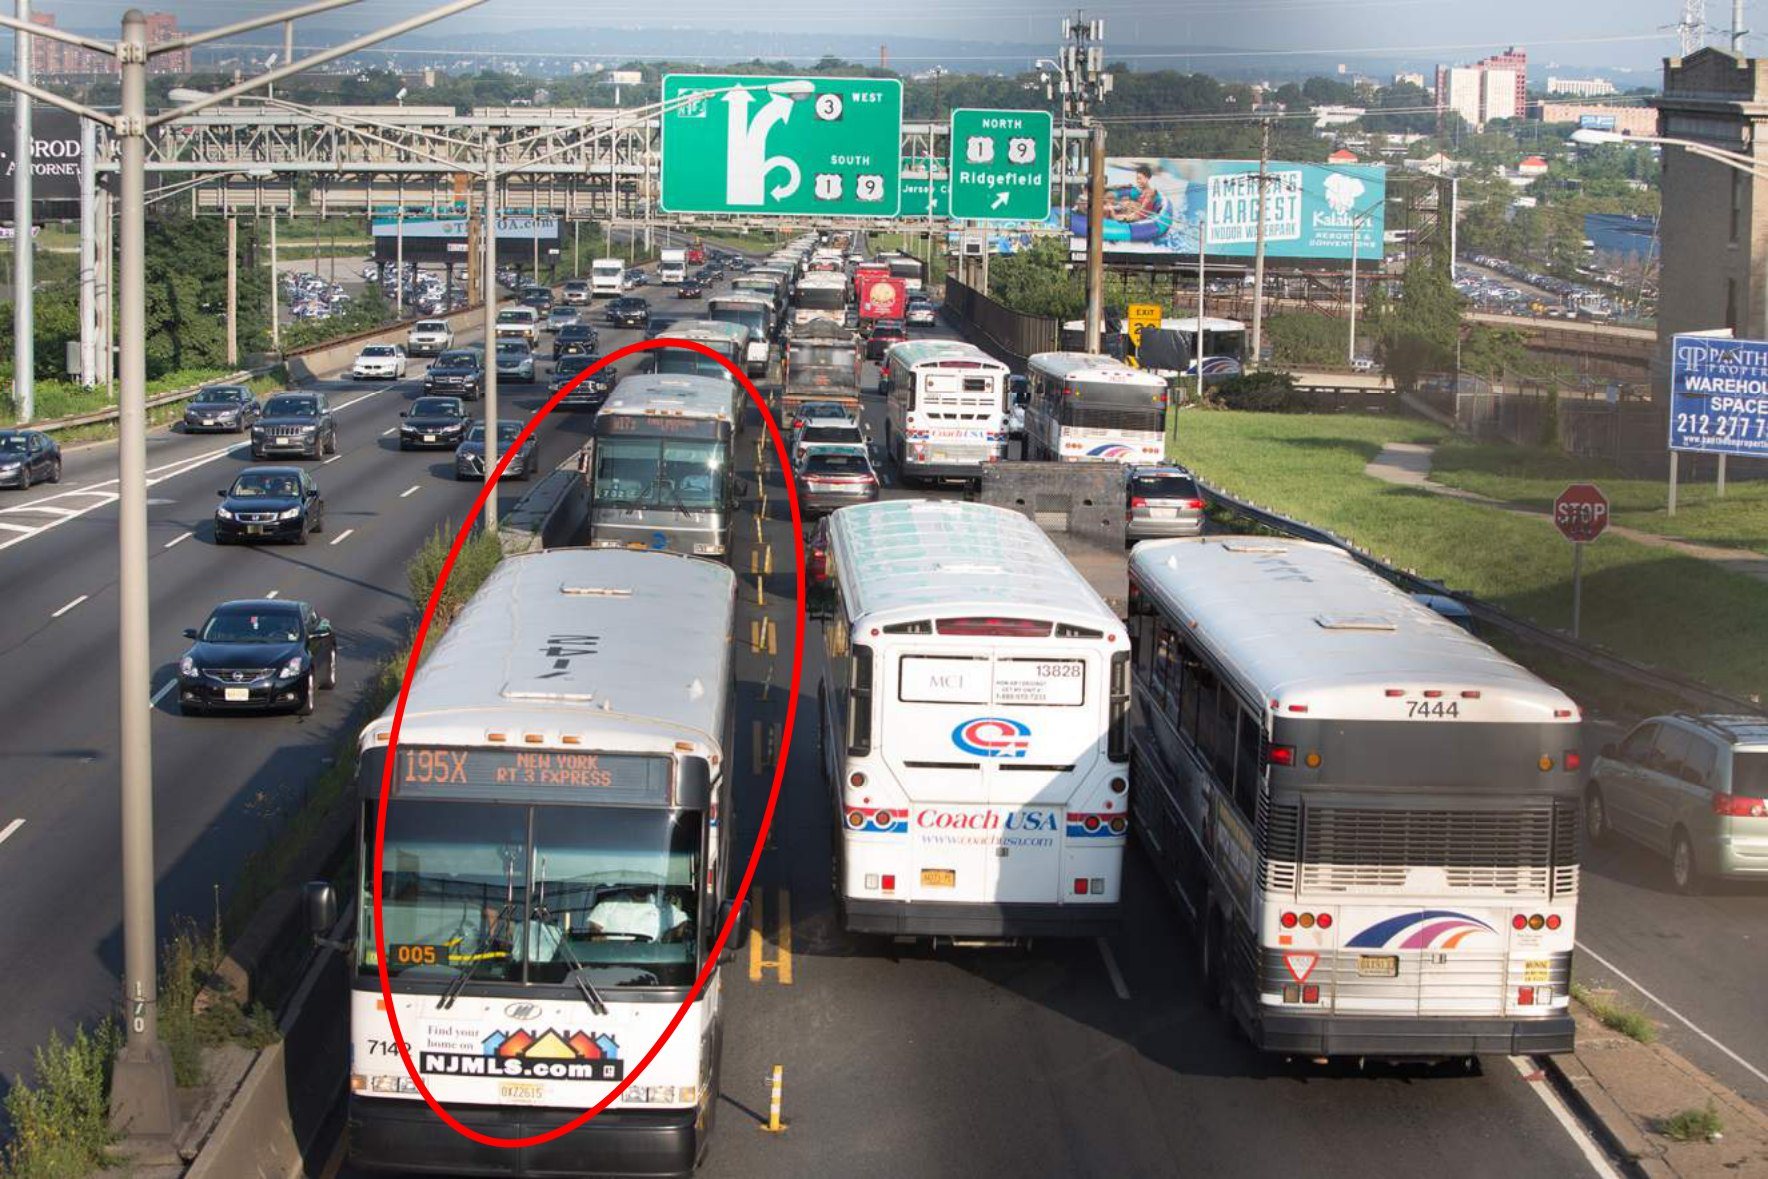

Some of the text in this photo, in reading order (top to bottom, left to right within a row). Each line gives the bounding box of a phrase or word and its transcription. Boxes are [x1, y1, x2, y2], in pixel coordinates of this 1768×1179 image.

[852, 92, 883, 103] WEST
[824, 99, 834, 115] 3
[982, 119, 1022, 129] NORTH
[1017, 143, 1027, 158] 9
[831, 155, 870, 166] SOUTH
[865, 180, 875, 195] 9
[960, 172, 1042, 187] Ridgefield
[1212, 174, 1297, 197] AMERA'S
[1711, 396, 1768, 415] SPACE
[1677, 412, 1709, 434] 212
[1716, 415, 1749, 438] 277
[1558, 502, 1606, 523] STOP
[1037, 665, 1081, 678] 13828
[1405, 701, 1460, 718] 7444
[405, 750, 599, 784] 195X NEW YORK
[497, 767, 612, 787] RT 3 EXPRESS
[917, 808, 1058, 831] Coach USA
[922, 834, 1054, 848] www.coachusa.com
[398, 945, 436, 964] 005
[428, 1025, 480, 1039] Find your
[427, 1038, 474, 1050] home on
[426, 1054, 593, 1079] NJMLS.com
